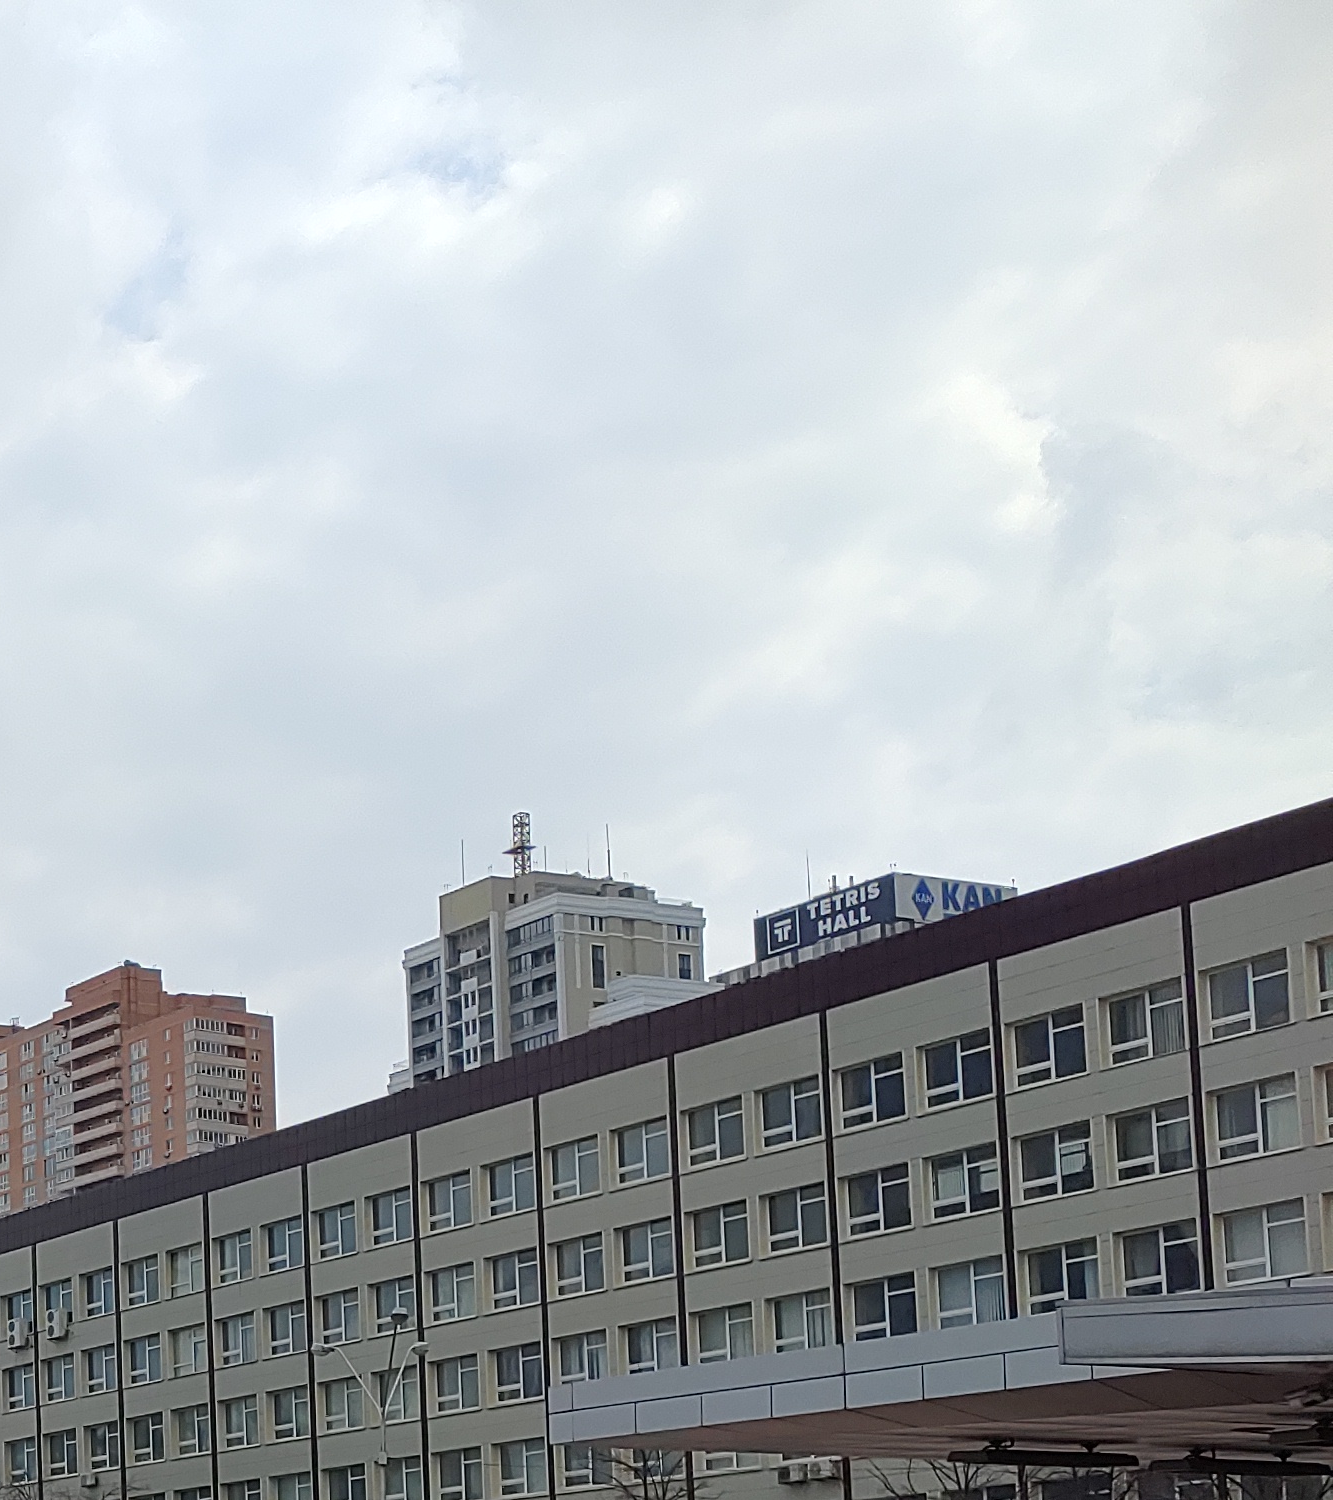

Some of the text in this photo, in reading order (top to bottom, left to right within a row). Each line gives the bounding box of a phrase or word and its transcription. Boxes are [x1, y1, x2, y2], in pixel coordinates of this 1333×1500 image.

[806, 881, 881, 920] TETRIS
[915, 892, 933, 904] KAN
[941, 880, 1003, 914] KAN
[818, 906, 872, 937] HALL
